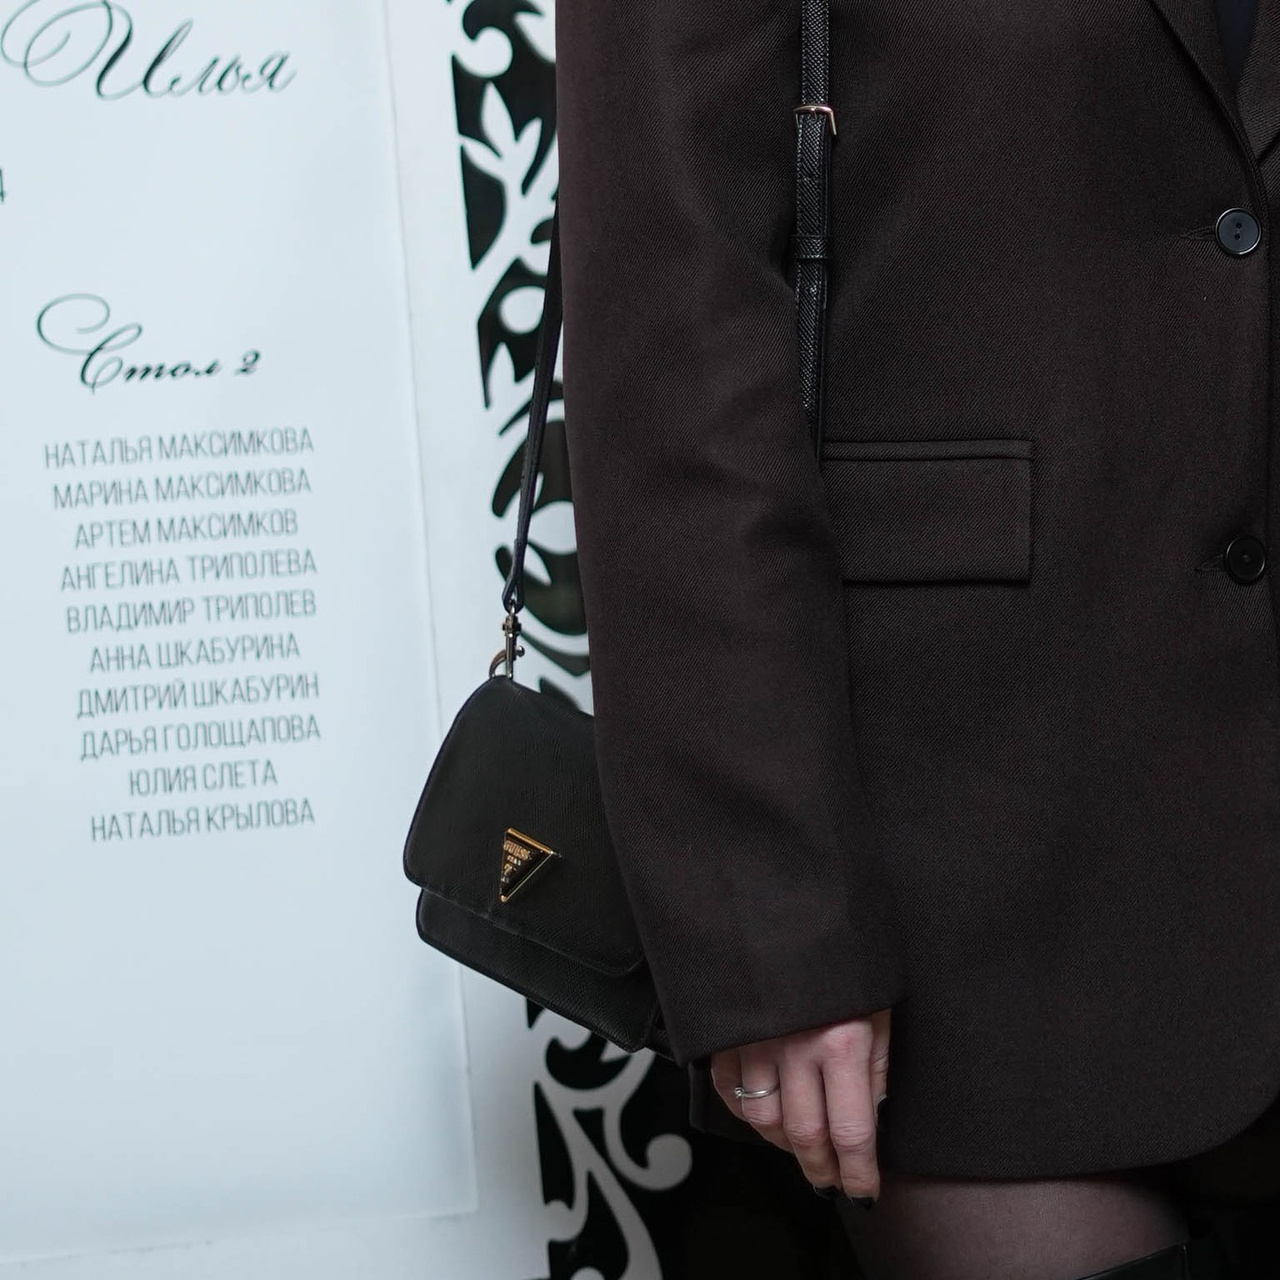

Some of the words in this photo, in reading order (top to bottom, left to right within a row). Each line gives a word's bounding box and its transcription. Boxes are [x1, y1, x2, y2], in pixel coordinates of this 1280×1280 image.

[37, 293, 222, 394] Стол
[234, 349, 261, 376] 2
[44, 435, 153, 469] НАТАЛЬЯ
[158, 427, 315, 460] МАКСИМКОВА
[53, 479, 149, 510] МАРИНА
[155, 468, 312, 503] МАКСИМКОВА
[74, 519, 151, 549] АРТЕМ
[157, 508, 298, 544] МАКСИМКОВ
[60, 557, 180, 591] АНГЕЛИНА
[187, 548, 318, 582] ТРИПОЛЕВА
[67, 597, 195, 634] ВЛАДИМИР
[202, 589, 317, 622] ТРИПОЛЕВ
[90, 643, 151, 673] АННА
[158, 632, 300, 669] ШКАБУРИНА
[77, 678, 187, 719] ДМИТРИЙ
[193, 672, 320, 708] ШКАБУРИН
[81, 725, 157, 761] ДАРЬЯ
[163, 714, 320, 751] ГОЛОЩАПОВА
[129, 765, 197, 796] ЮЛИЯ
[203, 759, 278, 790] СЛЕТА
[92, 806, 200, 842] НАТАЛЬЯ
[205, 798, 316, 832] КРЫЛОВА
